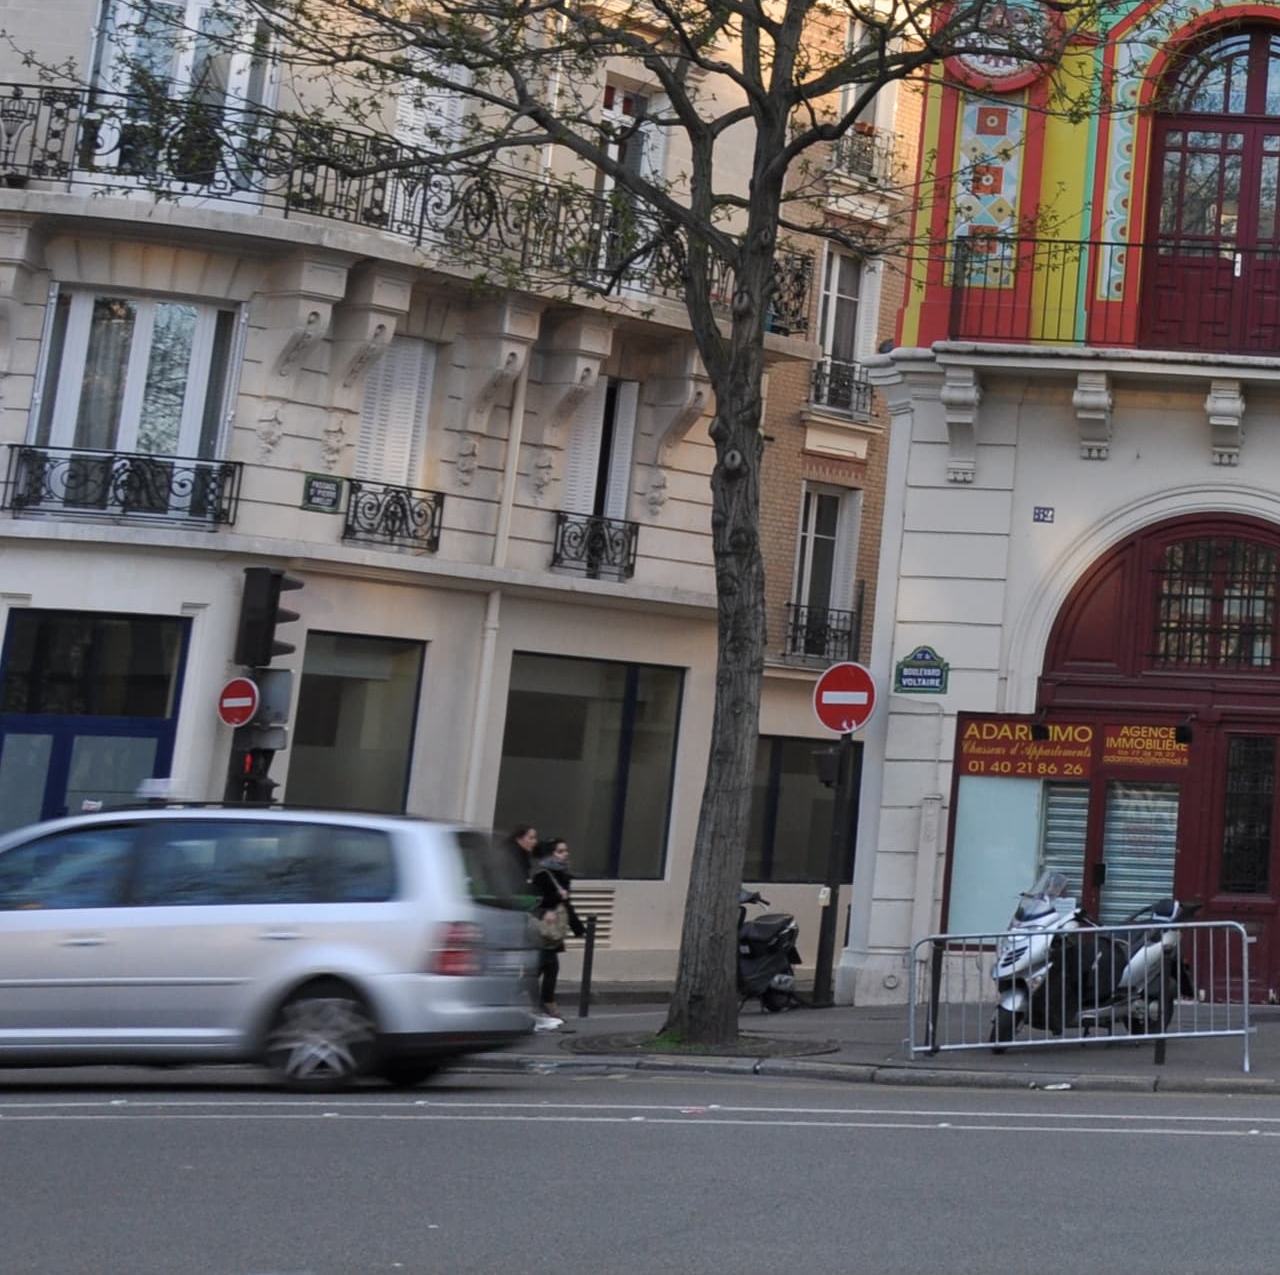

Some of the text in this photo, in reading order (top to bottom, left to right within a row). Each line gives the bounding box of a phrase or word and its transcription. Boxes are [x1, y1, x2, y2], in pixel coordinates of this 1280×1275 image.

[903, 668, 941, 676] BOULEVARD
[902, 678, 940, 686] VOLTAIRE
[1120, 726, 1176, 739] AGENCE
[961, 739, 1006, 755] Chasseur
[968, 760, 1084, 776] 01 40 21 86 26
